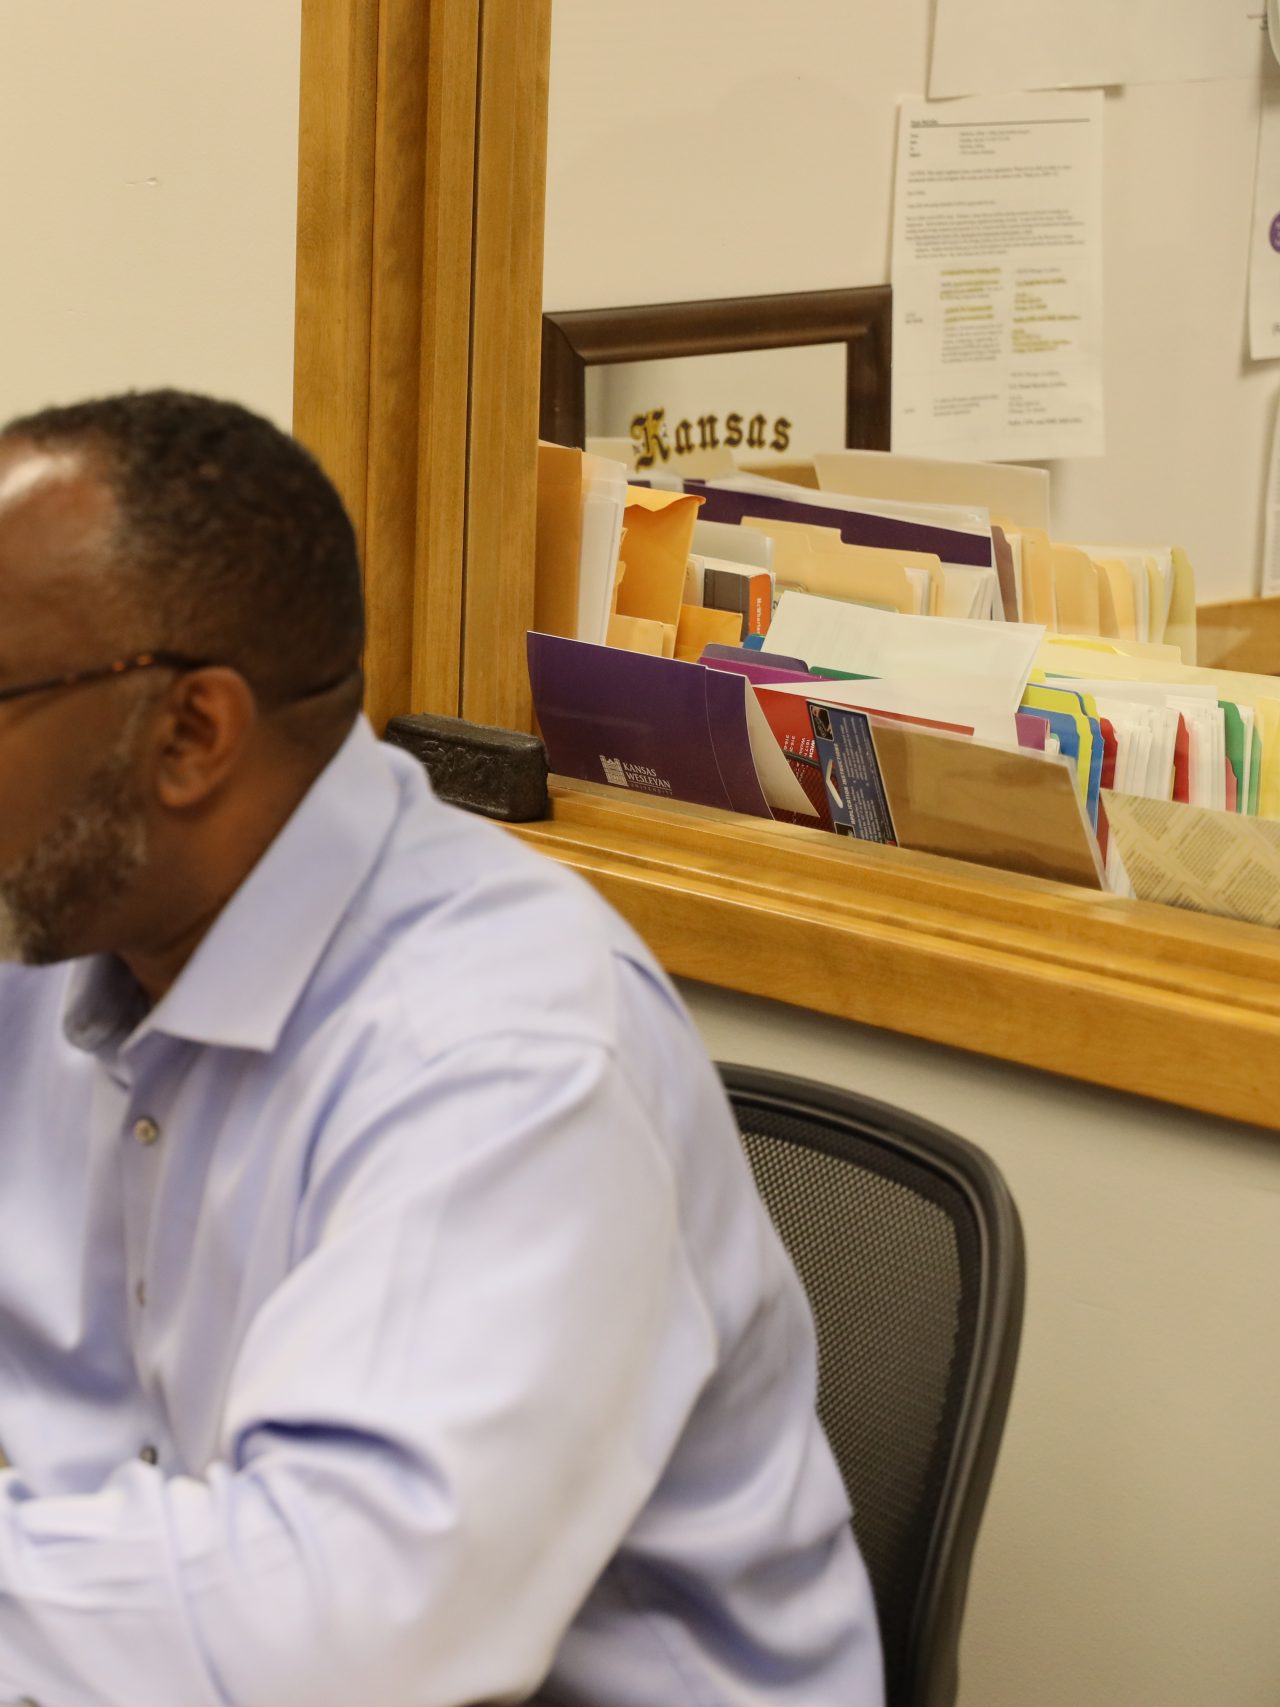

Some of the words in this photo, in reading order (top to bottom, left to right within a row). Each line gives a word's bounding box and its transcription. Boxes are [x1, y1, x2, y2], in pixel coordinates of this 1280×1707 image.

[630, 406, 792, 473] Kansas
[622, 762, 657, 777] KANSAS
[625, 772, 671, 788] WESLEYAN
